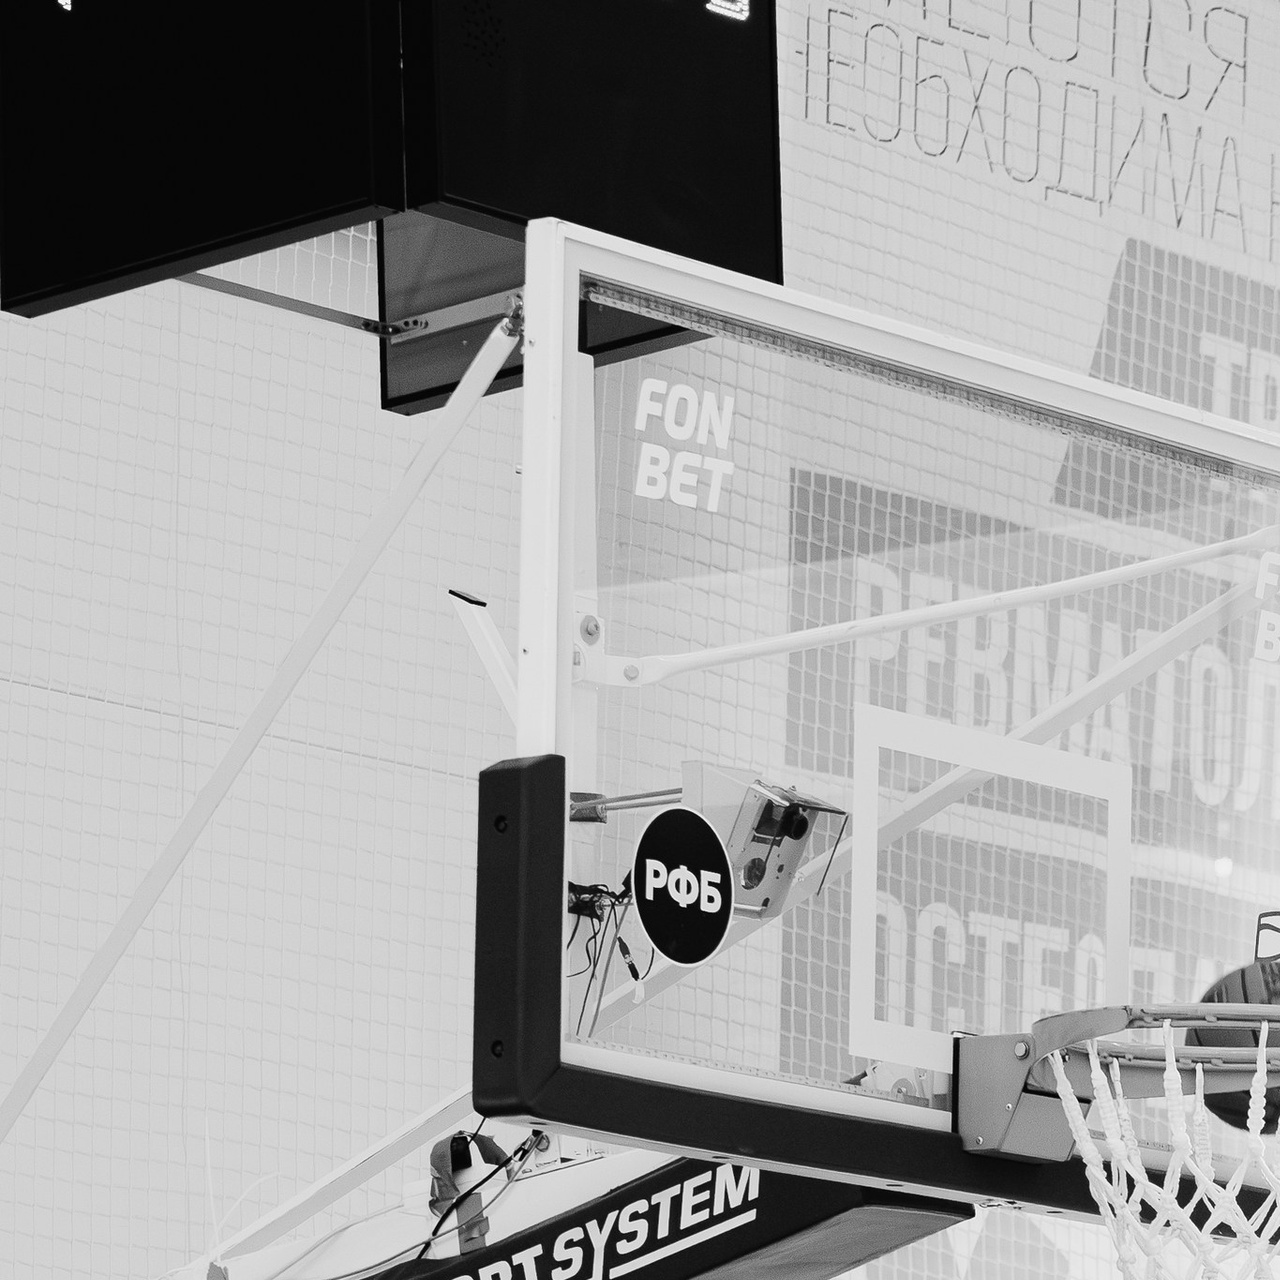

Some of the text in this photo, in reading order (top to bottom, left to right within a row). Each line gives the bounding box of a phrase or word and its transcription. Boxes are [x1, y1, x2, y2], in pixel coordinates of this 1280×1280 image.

[886, 0, 1248, 122] ЮТСЯ
[634, 377, 736, 450] FON
[633, 441, 735, 513] BET
[644, 857, 723, 915] РФБ
